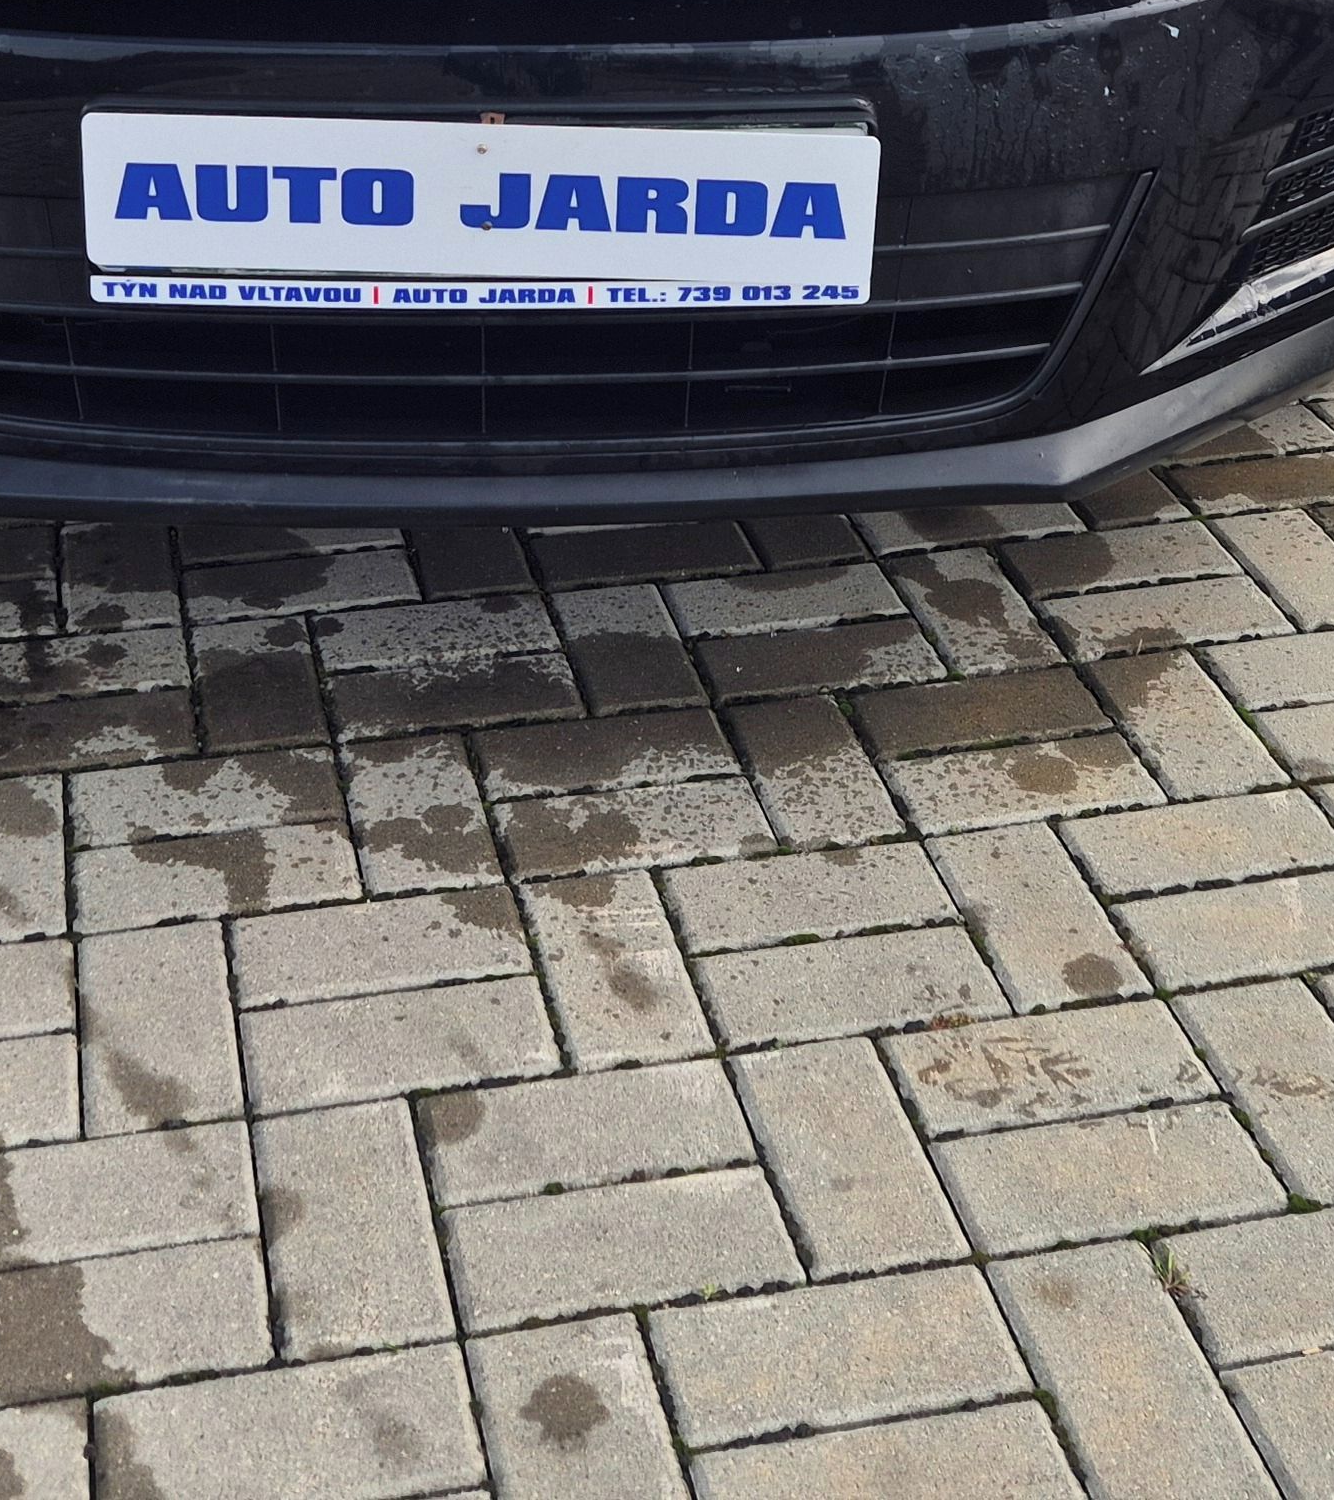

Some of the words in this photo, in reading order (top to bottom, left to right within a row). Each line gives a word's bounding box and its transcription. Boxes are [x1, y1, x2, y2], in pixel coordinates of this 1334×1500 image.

[114, 162, 416, 227] AUTO
[459, 172, 847, 240] JARDA
[102, 279, 159, 300] TÝN
[168, 283, 228, 301] NAD
[238, 284, 362, 303] VLTAVOU
[392, 287, 468, 305] AUTO
[478, 287, 576, 305] JARDA
[606, 287, 667, 303] TEL.:
[677, 285, 732, 302] 739
[741, 285, 792, 301] 013
[801, 284, 859, 301] 245
